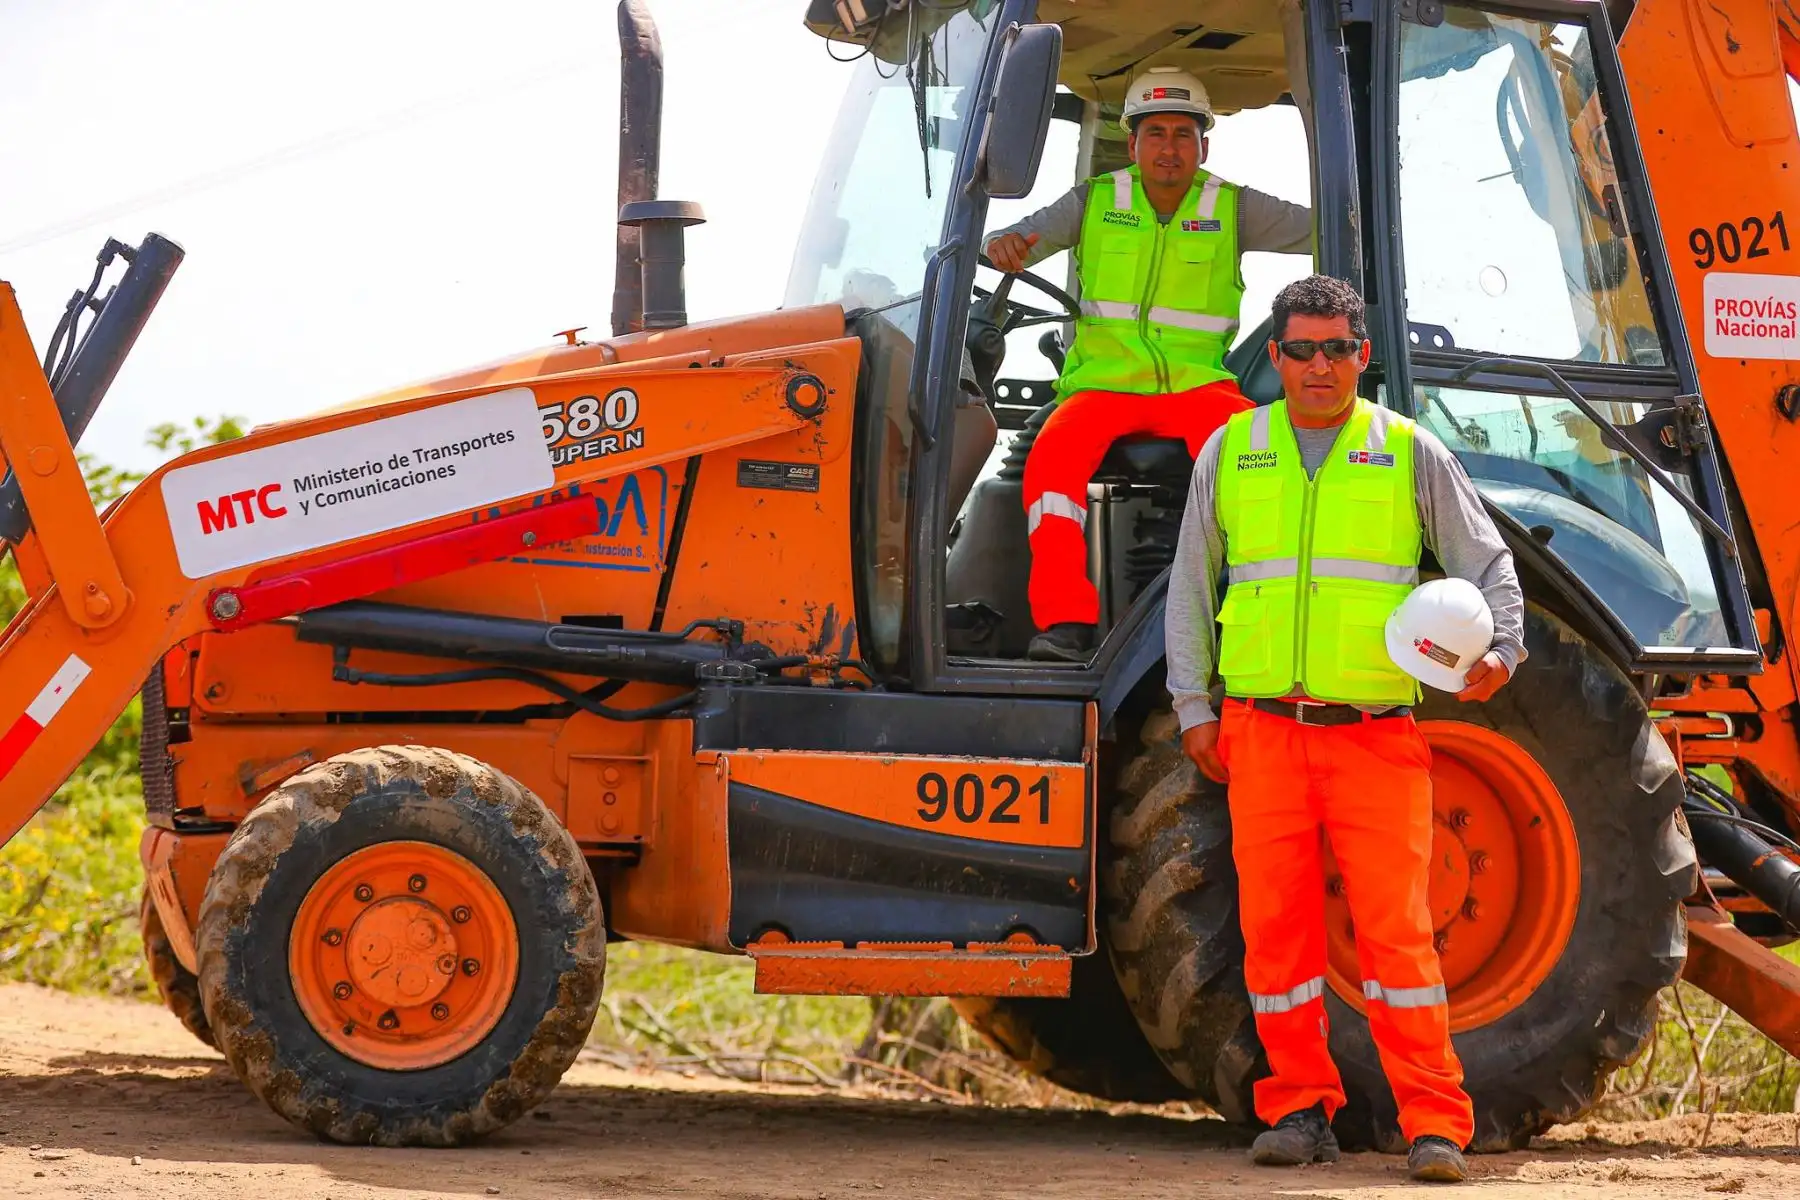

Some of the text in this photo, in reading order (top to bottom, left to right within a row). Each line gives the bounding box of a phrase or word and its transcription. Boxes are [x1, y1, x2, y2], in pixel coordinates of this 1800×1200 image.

[1103, 217, 1140, 228] Nacional
[1688, 210, 1790, 269] 9021
[1714, 296, 1798, 319] PROVÍAS
[1715, 318, 1796, 339] Nacional
[537, 386, 640, 446] 580
[623, 427, 645, 450] N
[293, 428, 516, 494] Ministerio de Transportes
[1237, 459, 1277, 471] Nacional
[1238, 451, 1278, 463] PROVÍAS
[789, 467, 815, 475] CASE
[299, 499, 311, 515] y
[314, 463, 457, 508] Comunicaciones
[196, 483, 288, 535] MTC
[916, 772, 1050, 825] 9021
